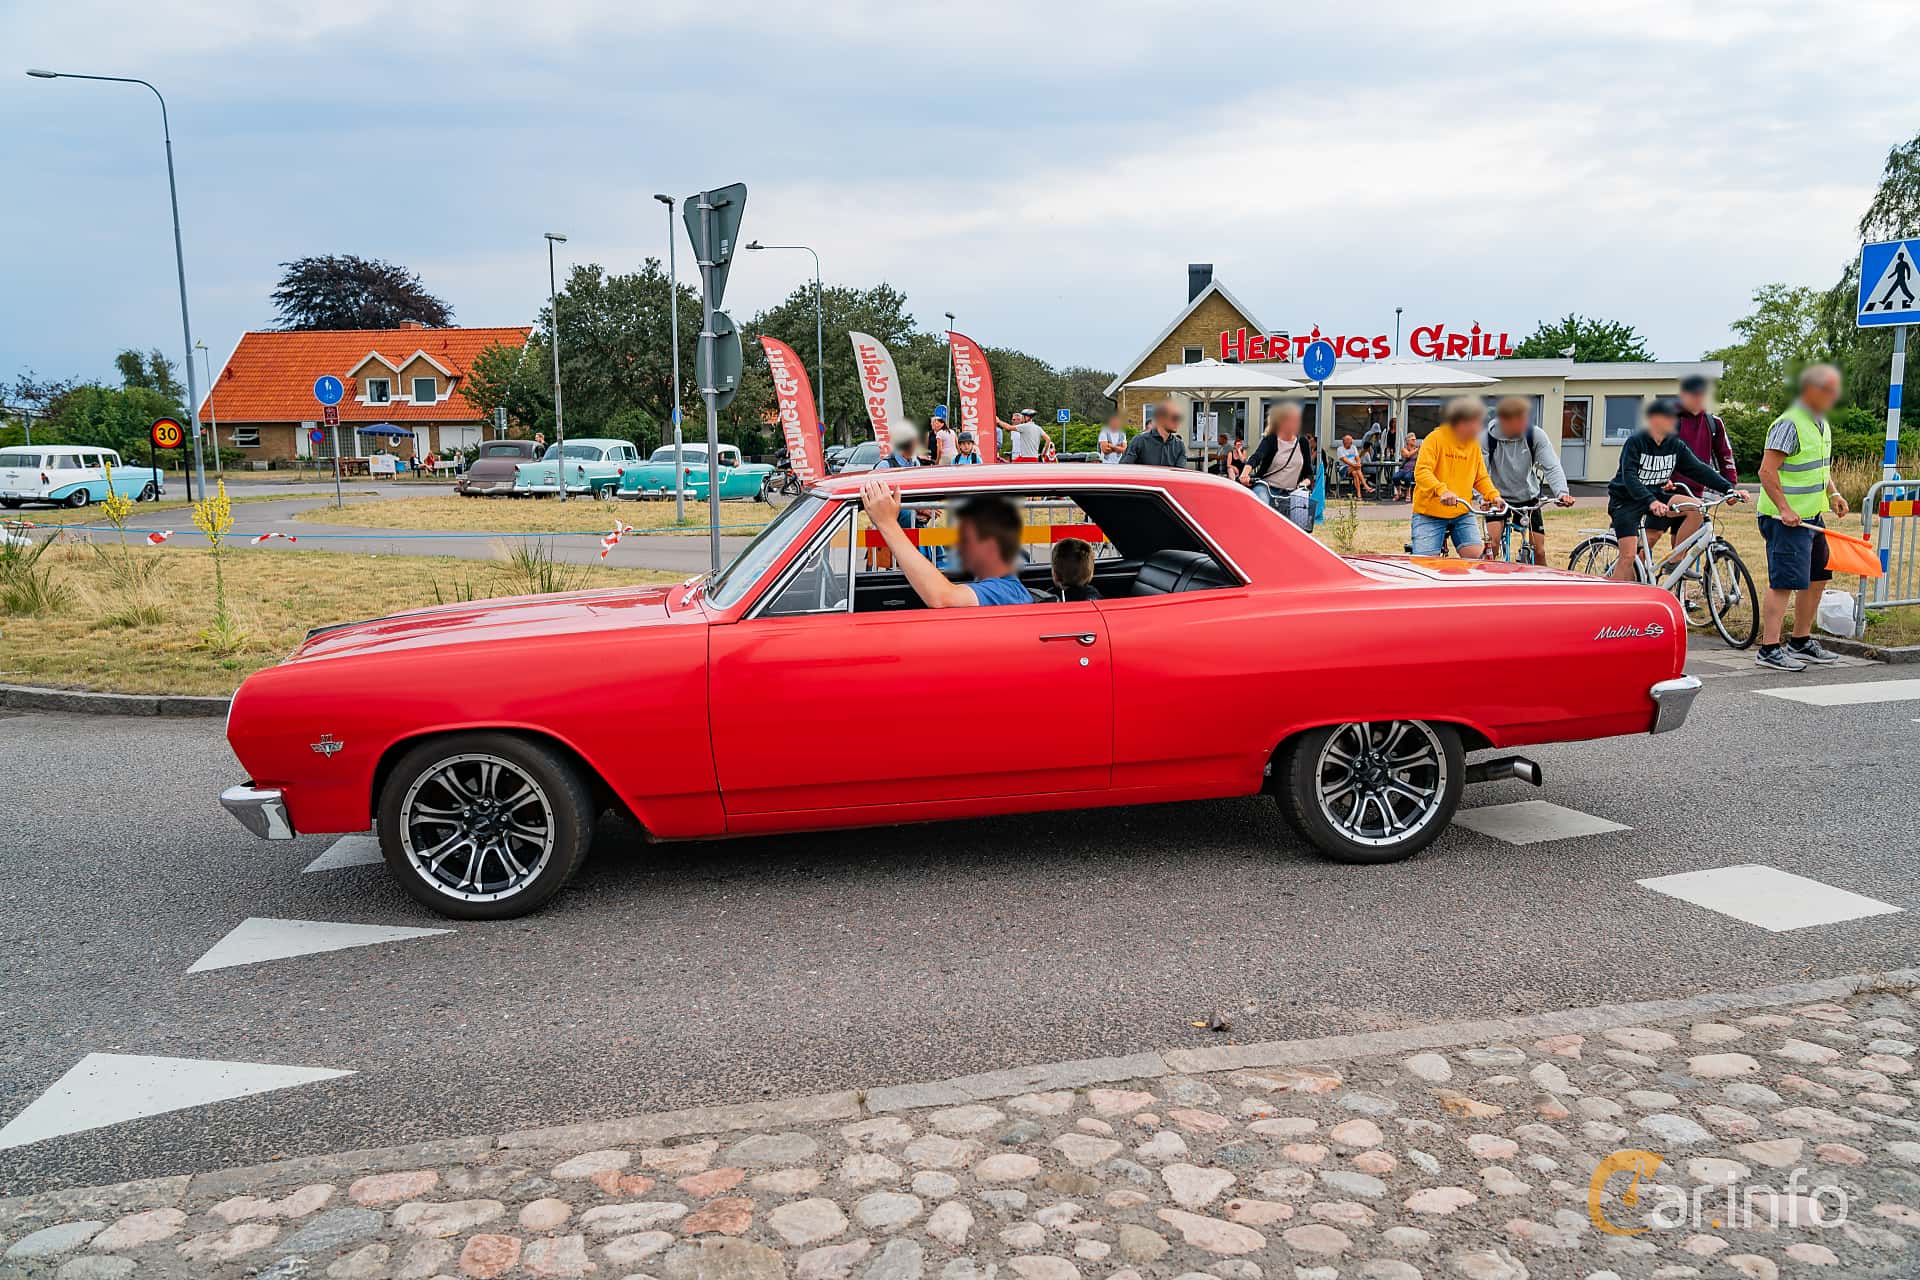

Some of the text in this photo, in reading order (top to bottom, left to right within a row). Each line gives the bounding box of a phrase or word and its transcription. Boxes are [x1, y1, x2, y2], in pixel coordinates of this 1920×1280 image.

[158, 427, 178, 441] 30
[1593, 622, 1665, 640] Malibu SS
